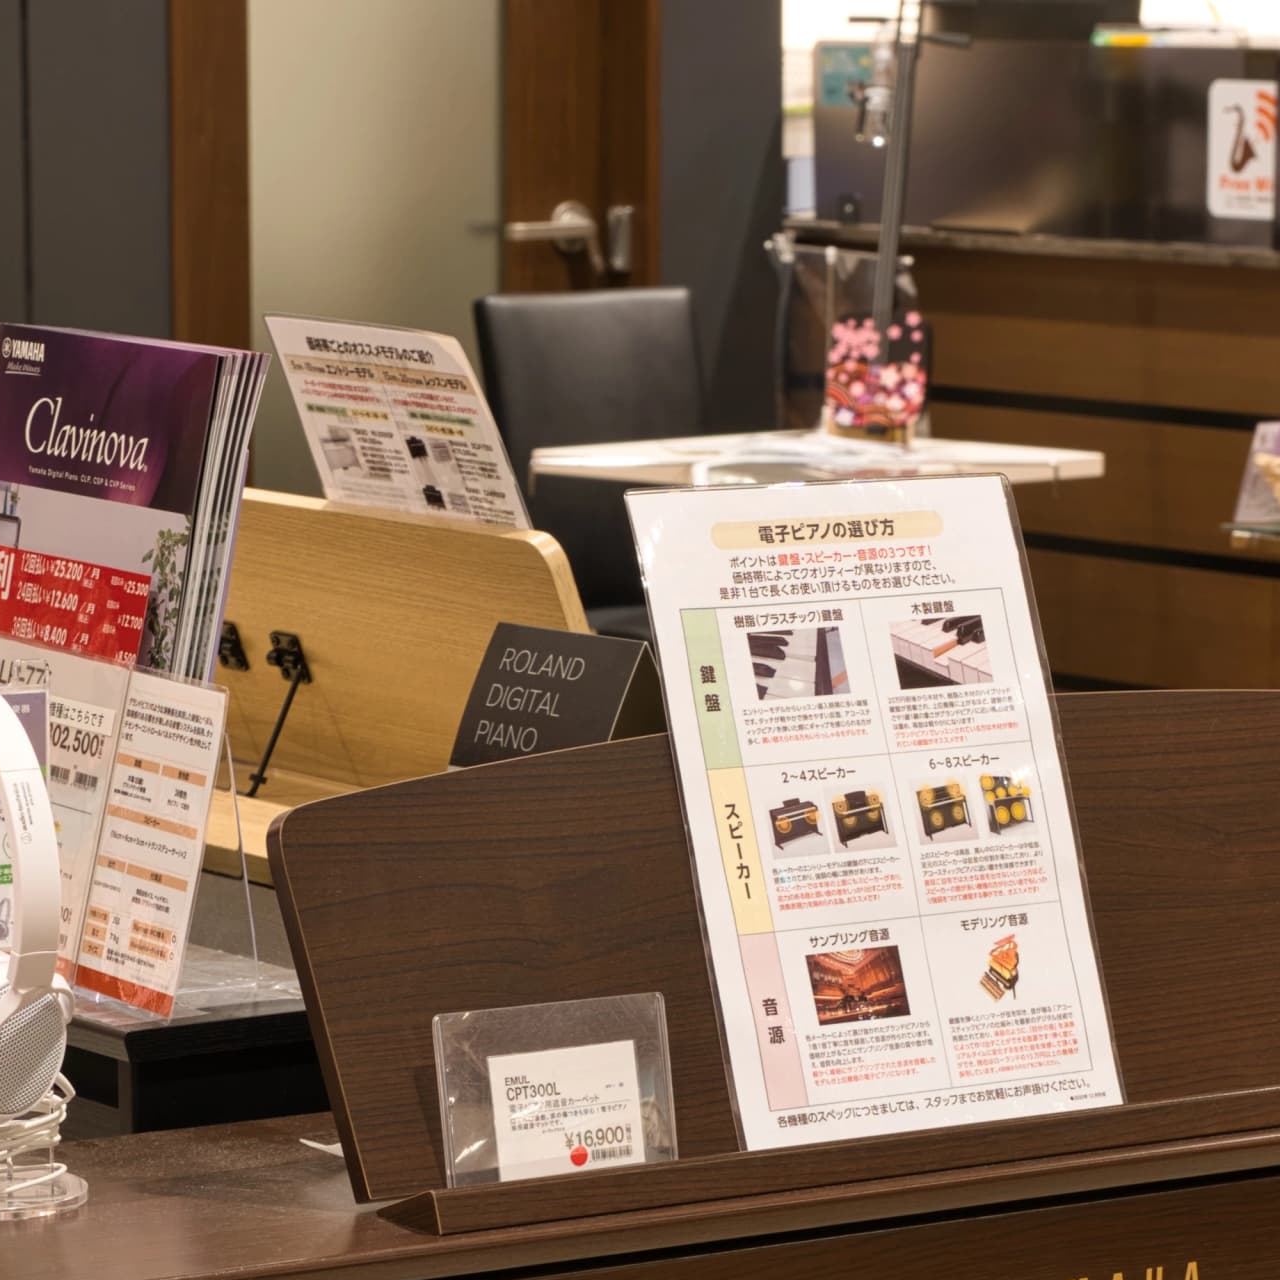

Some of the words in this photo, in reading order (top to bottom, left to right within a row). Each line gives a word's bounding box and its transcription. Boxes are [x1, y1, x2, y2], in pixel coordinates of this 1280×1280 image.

[12, 338, 45, 362] YAMAHA
[25, 397, 149, 471] Clavinova
[28, 466, 47, 476] Yamaha
[47, 468, 64, 479] Digital
[64, 471, 79, 482] Piano
[120, 481, 136, 492] Series
[758, 518, 896, 544] 電子ピアノの選び方
[732, 560, 937, 585] 価格帯によってクオリティーが異なりますので、
[720, 574, 957, 600] 是非1台で長くお使い頂けるものをお選びください。
[733, 608, 844, 629] 樹脂(プラスチック)鍵盤
[911, 600, 955, 615] 木製鍵盤
[499, 648, 585, 680] ROLAND
[486, 683, 560, 717] DIGITAL
[50, 722, 99, 757] 02,500
[474, 720, 538, 751] PIANO
[929, 753, 1000, 770] 6〜8スピーカー
[781, 766, 856, 784] 2〜4スピーカー
[724, 803, 752, 900] スピーカー
[960, 913, 1029, 932] モデリング音源
[810, 927, 890, 948] サンプリング音源
[762, 998, 786, 1045] 音源
[504, 1075, 530, 1087] EMUL
[506, 1082, 561, 1102] CPT300L
[777, 1078, 1093, 1129] 各機種のスペックにつきましては、スタッフまでお気軽にお声掛けください。
[564, 1125, 624, 1150] ¥16,900
